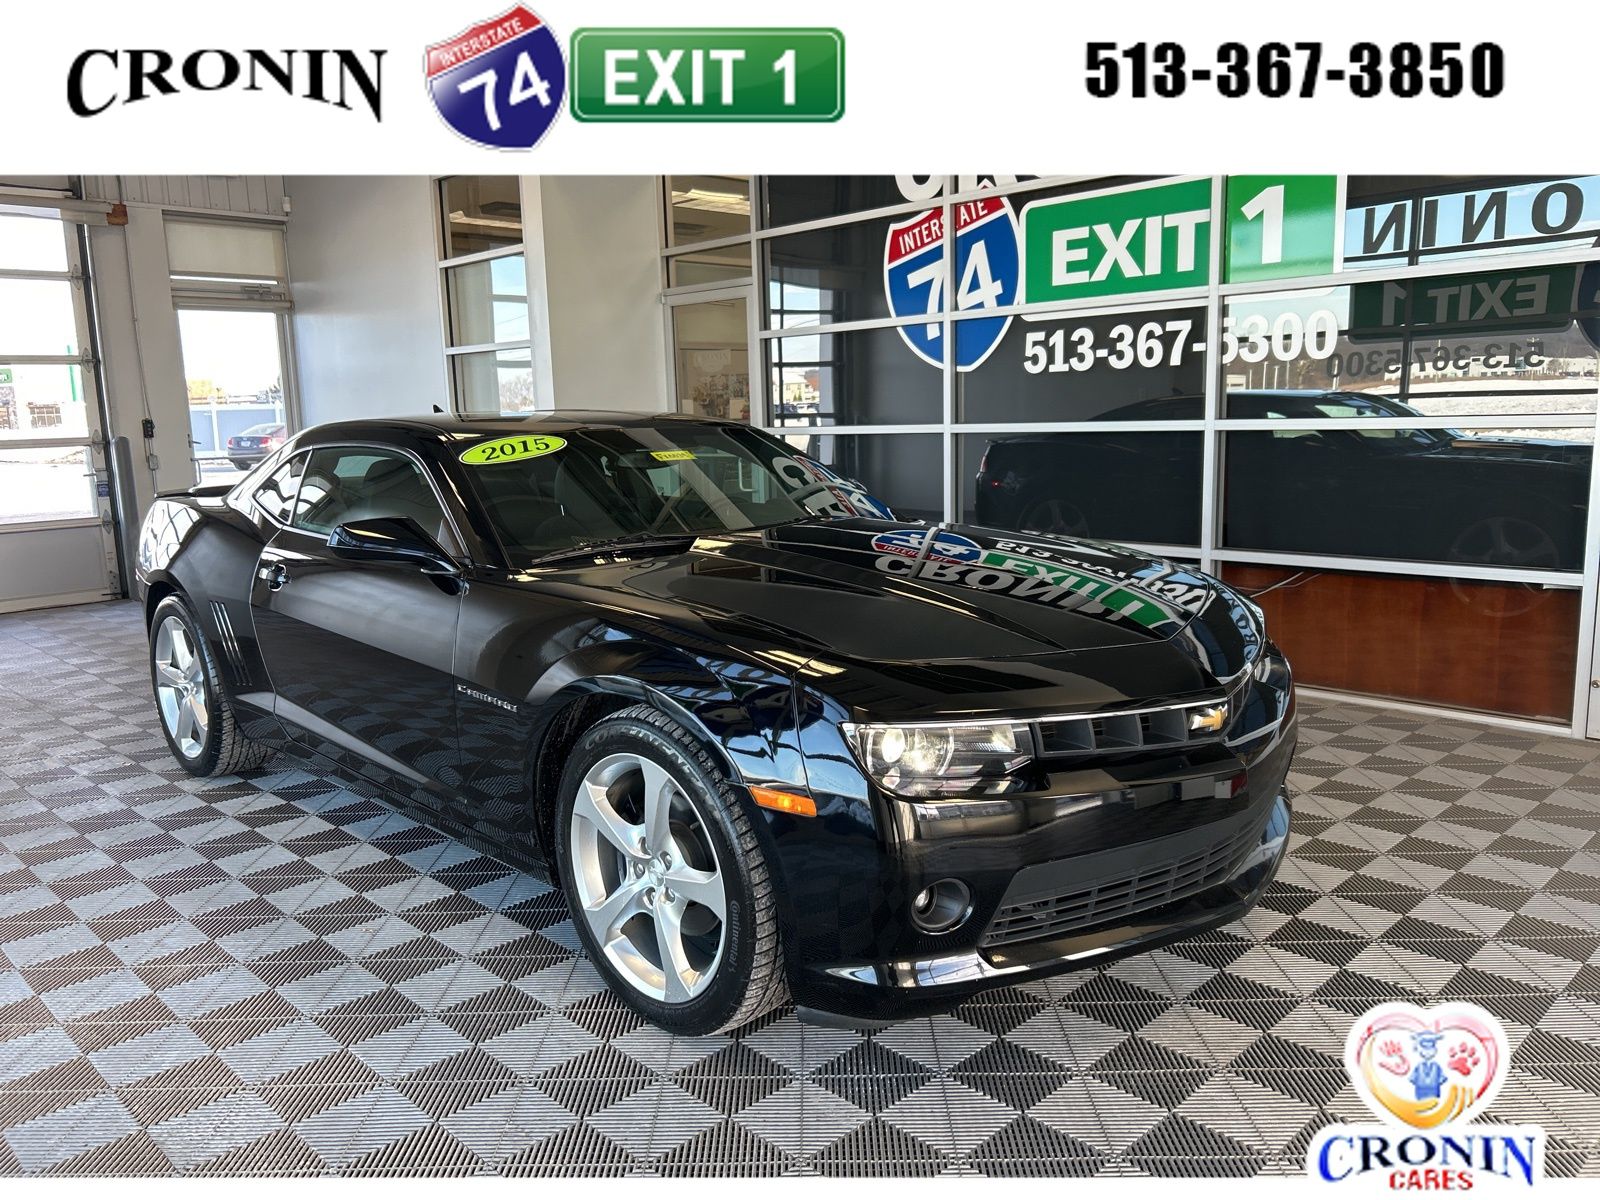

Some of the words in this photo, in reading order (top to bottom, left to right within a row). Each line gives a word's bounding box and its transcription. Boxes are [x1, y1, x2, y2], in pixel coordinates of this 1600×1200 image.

[899, 199, 988, 255] INTERATE
[1051, 209, 1211, 287] EXIT
[1241, 184, 1285, 265] 1
[906, 239, 1003, 341] 74
[1023, 309, 1338, 374] 513-367-5300
[481, 437, 551, 462] 2015
